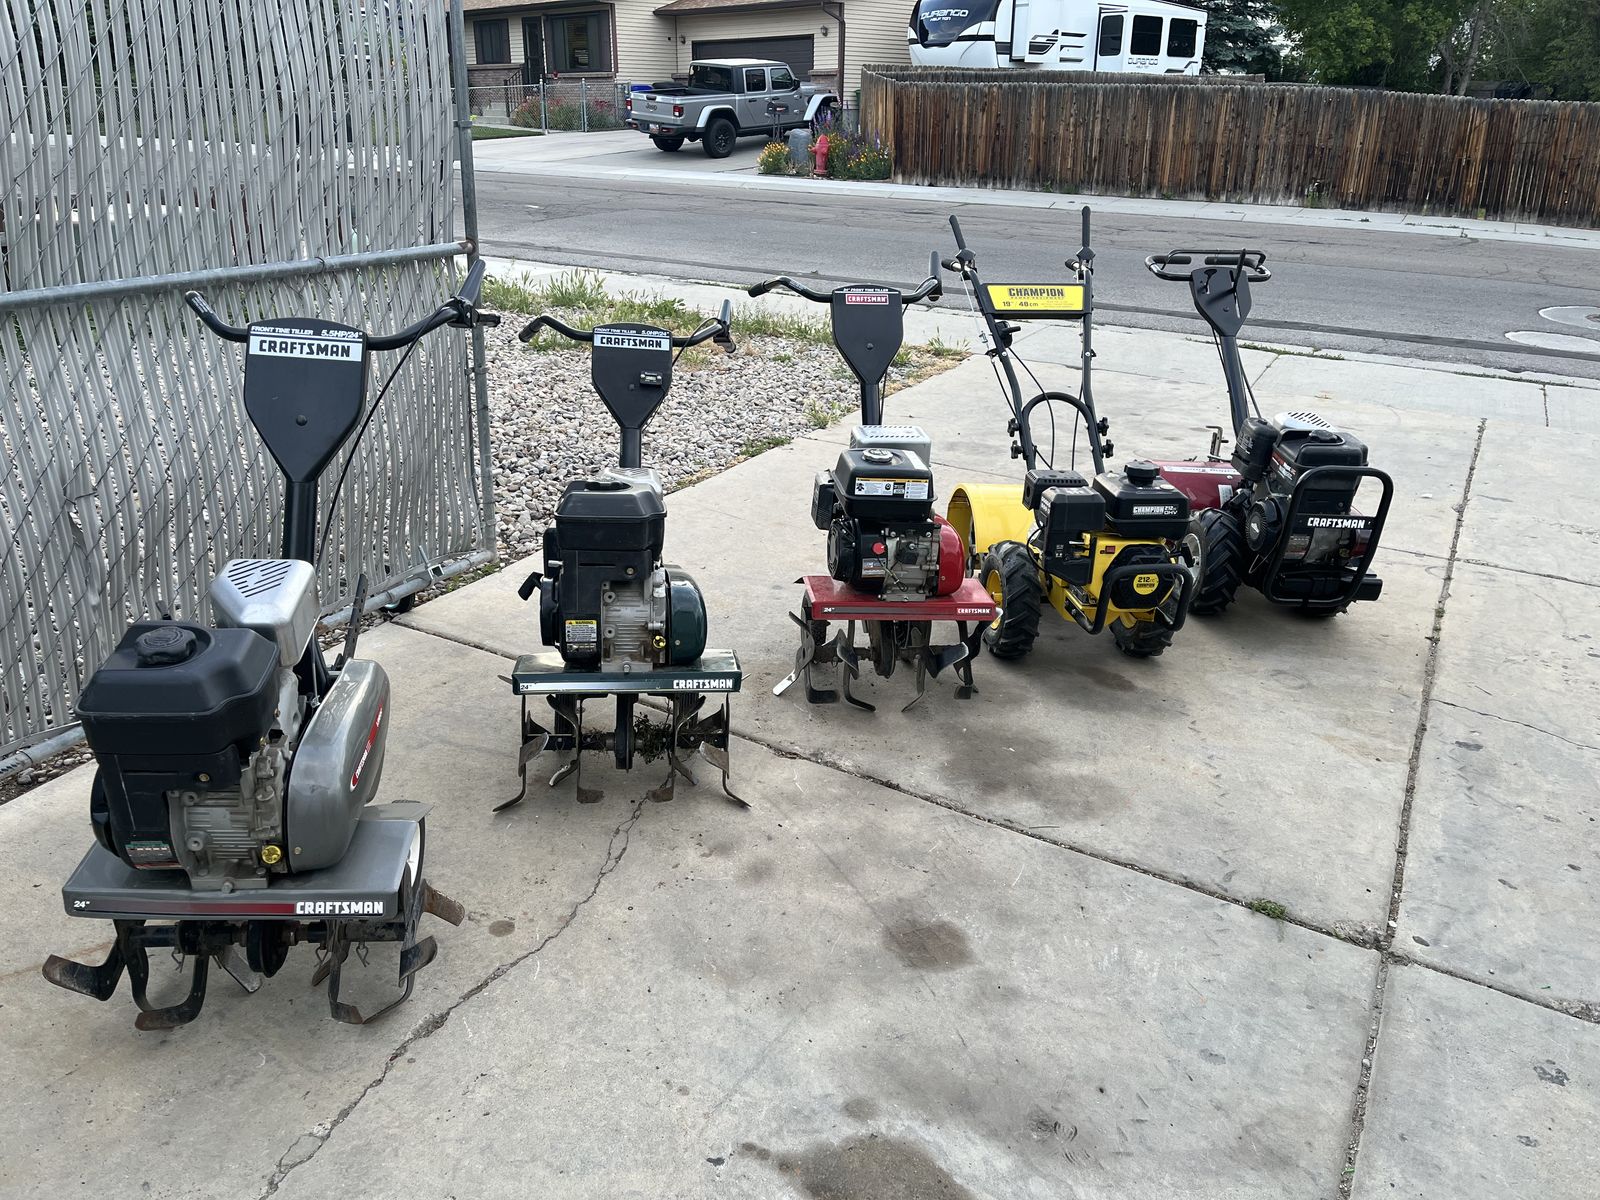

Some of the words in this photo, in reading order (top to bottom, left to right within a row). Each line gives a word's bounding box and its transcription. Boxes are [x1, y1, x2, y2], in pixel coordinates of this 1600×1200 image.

[921, 10, 969, 20] DURANGO
[1008, 288, 1065, 297] CHAMPION
[251, 325, 274, 333] FRONT
[291, 328, 313, 336] TILLER
[600, 336, 662, 349] CRAFTSMAN
[259, 339, 350, 358] CRAFTSMAN
[1307, 517, 1365, 529] CRAFTSMAN
[673, 679, 733, 689] CRAFTSMAN
[73, 900, 90, 909] 24"
[296, 901, 384, 915] CRAFTSMAN
